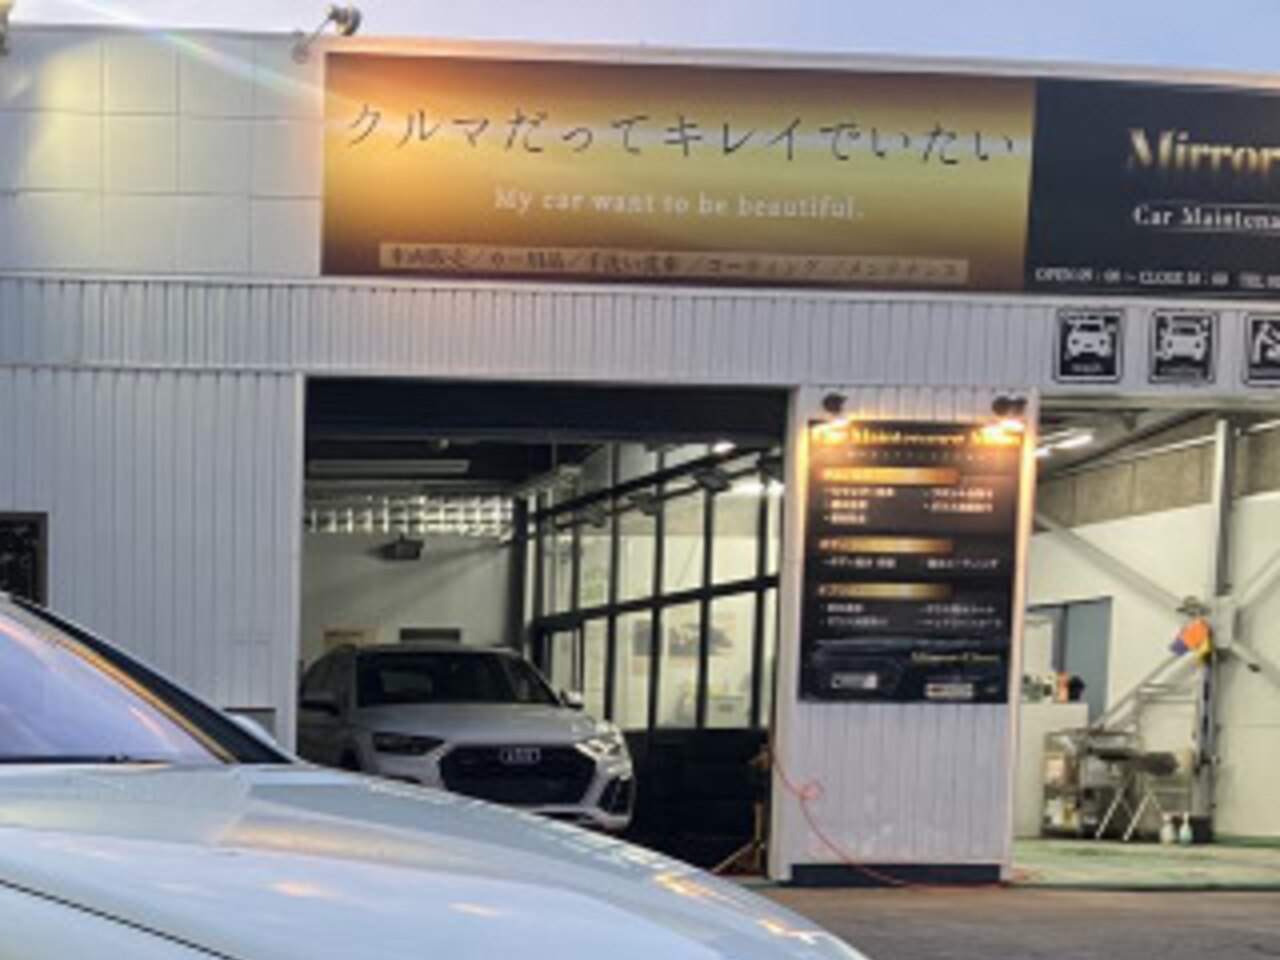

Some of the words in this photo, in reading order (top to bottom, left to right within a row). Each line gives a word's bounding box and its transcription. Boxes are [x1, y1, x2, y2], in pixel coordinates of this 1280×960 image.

[347, 103, 1014, 165] クルマだってキレイでいたい
[495, 186, 533, 216] My
[542, 193, 582, 211] car
[592, 193, 655, 213] want
[664, 192, 689, 214] to
[698, 192, 726, 215] be
[738, 192, 865, 220] beautiful.
[1132, 204, 1174, 226] Car
